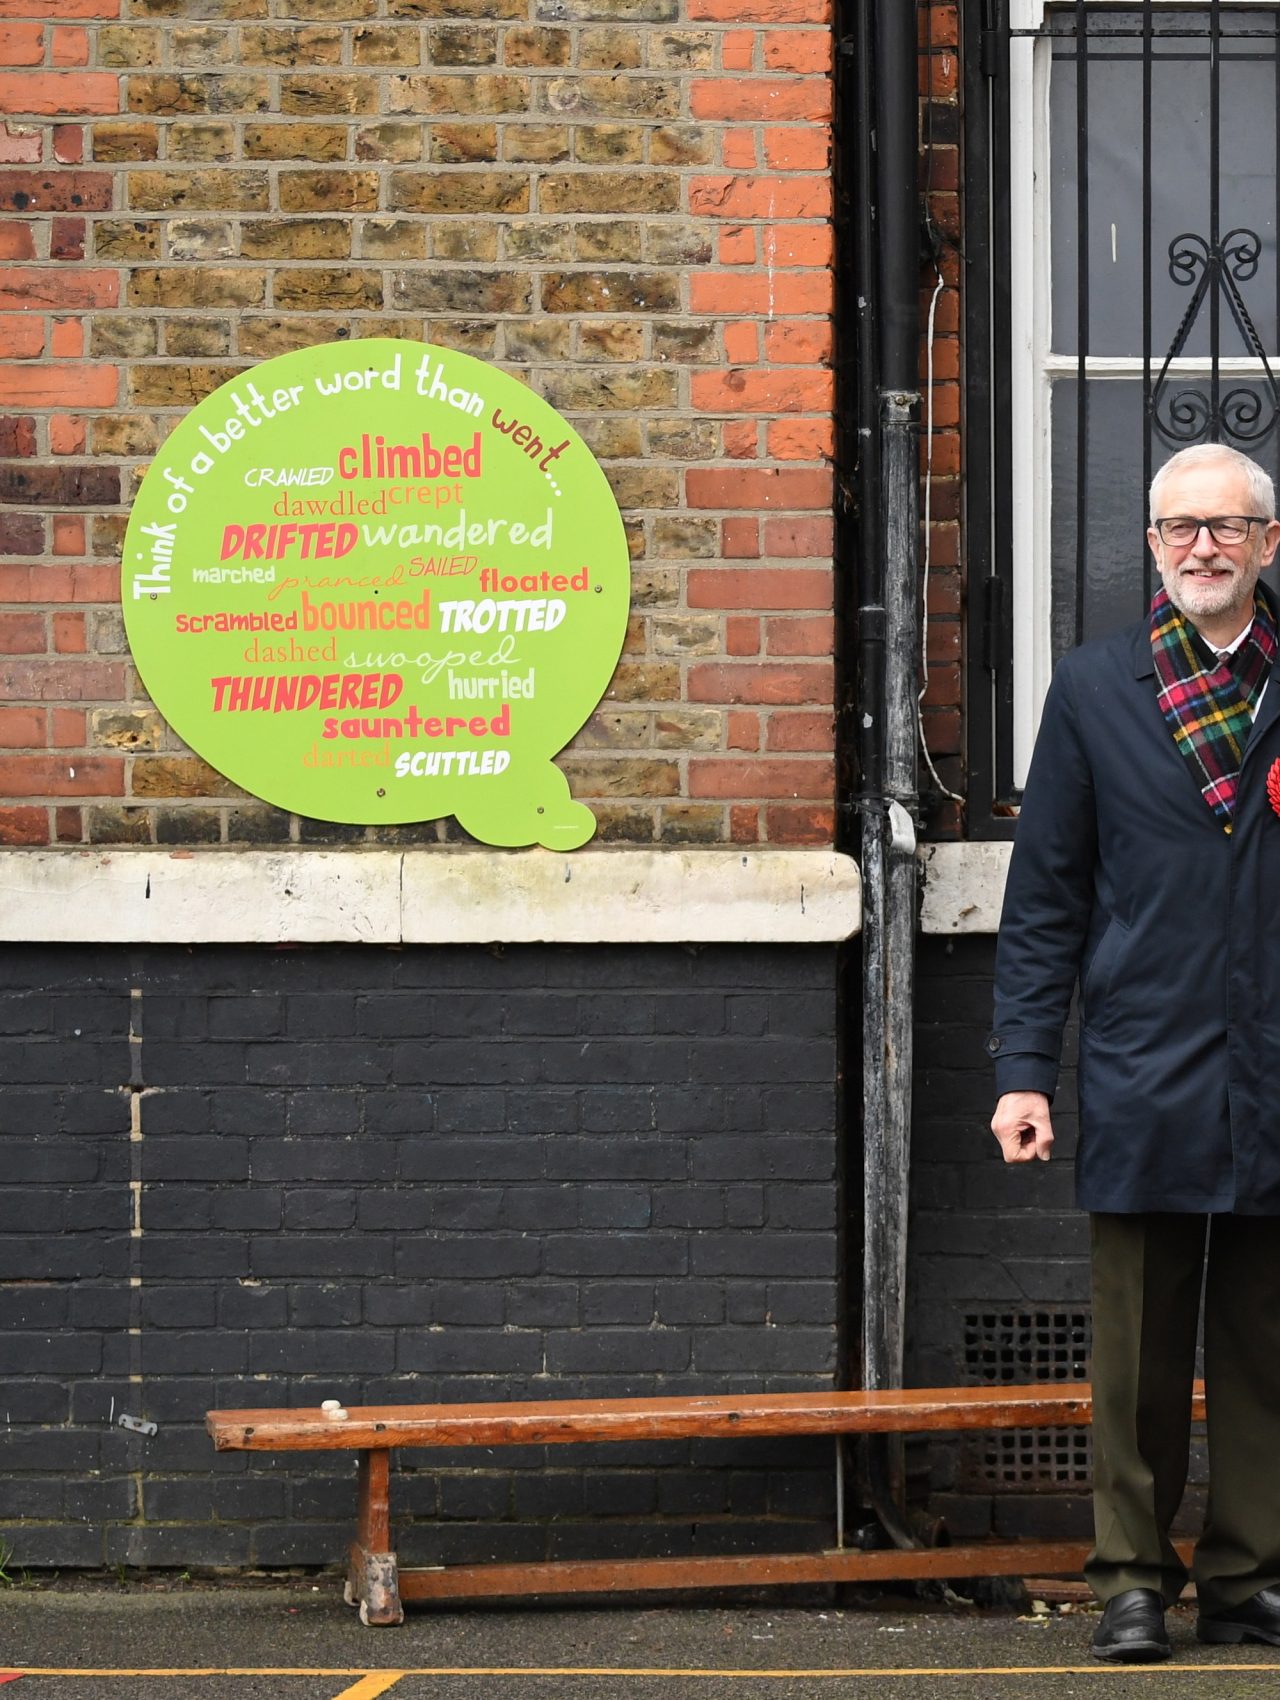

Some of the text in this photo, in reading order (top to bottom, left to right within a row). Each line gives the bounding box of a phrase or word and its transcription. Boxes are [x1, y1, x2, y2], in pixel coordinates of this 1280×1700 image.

[315, 353, 402, 397] word
[415, 353, 486, 418] than
[198, 381, 304, 454] better
[190, 451, 215, 475] a
[245, 432, 481, 487] CRAWLED climbed
[163, 466, 195, 514] of
[273, 483, 463, 516] dawdled crept
[220, 508, 553, 560] DRIFTED wandered
[133, 521, 177, 600] Think
[193, 555, 589, 600] marched pranced SAILED floated
[176, 589, 566, 633] scrambled bounced TROTTED
[244, 636, 521, 684] dashed swooped
[211, 667, 534, 713] THUNDERED hurried
[322, 704, 510, 738] sauntered
[303, 743, 510, 777] darted SCUTTLED
